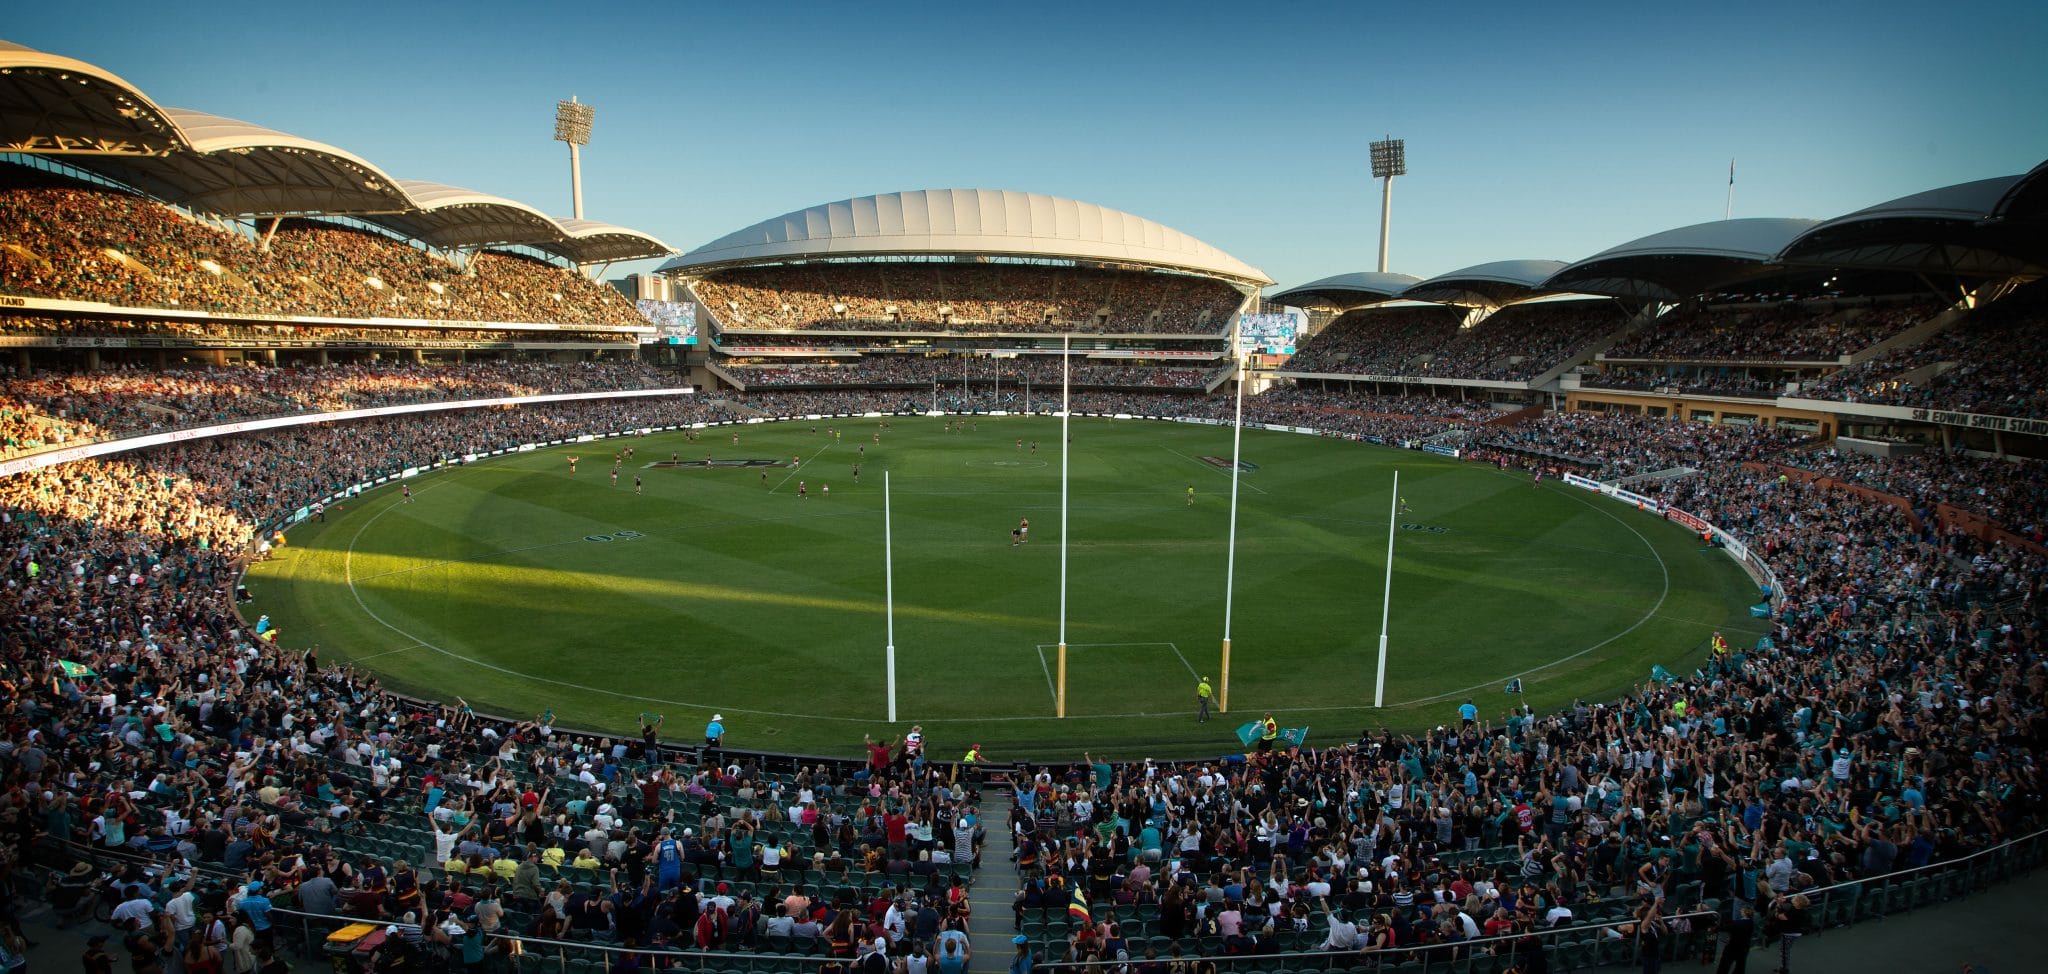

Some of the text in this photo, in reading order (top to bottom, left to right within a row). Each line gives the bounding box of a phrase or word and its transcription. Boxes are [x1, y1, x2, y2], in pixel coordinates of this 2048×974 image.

[1932, 411, 1968, 425] EDWIN
[1971, 415, 2007, 429] SMITH
[2010, 419, 2048, 435] STAND
[176, 821, 183, 833] 7
